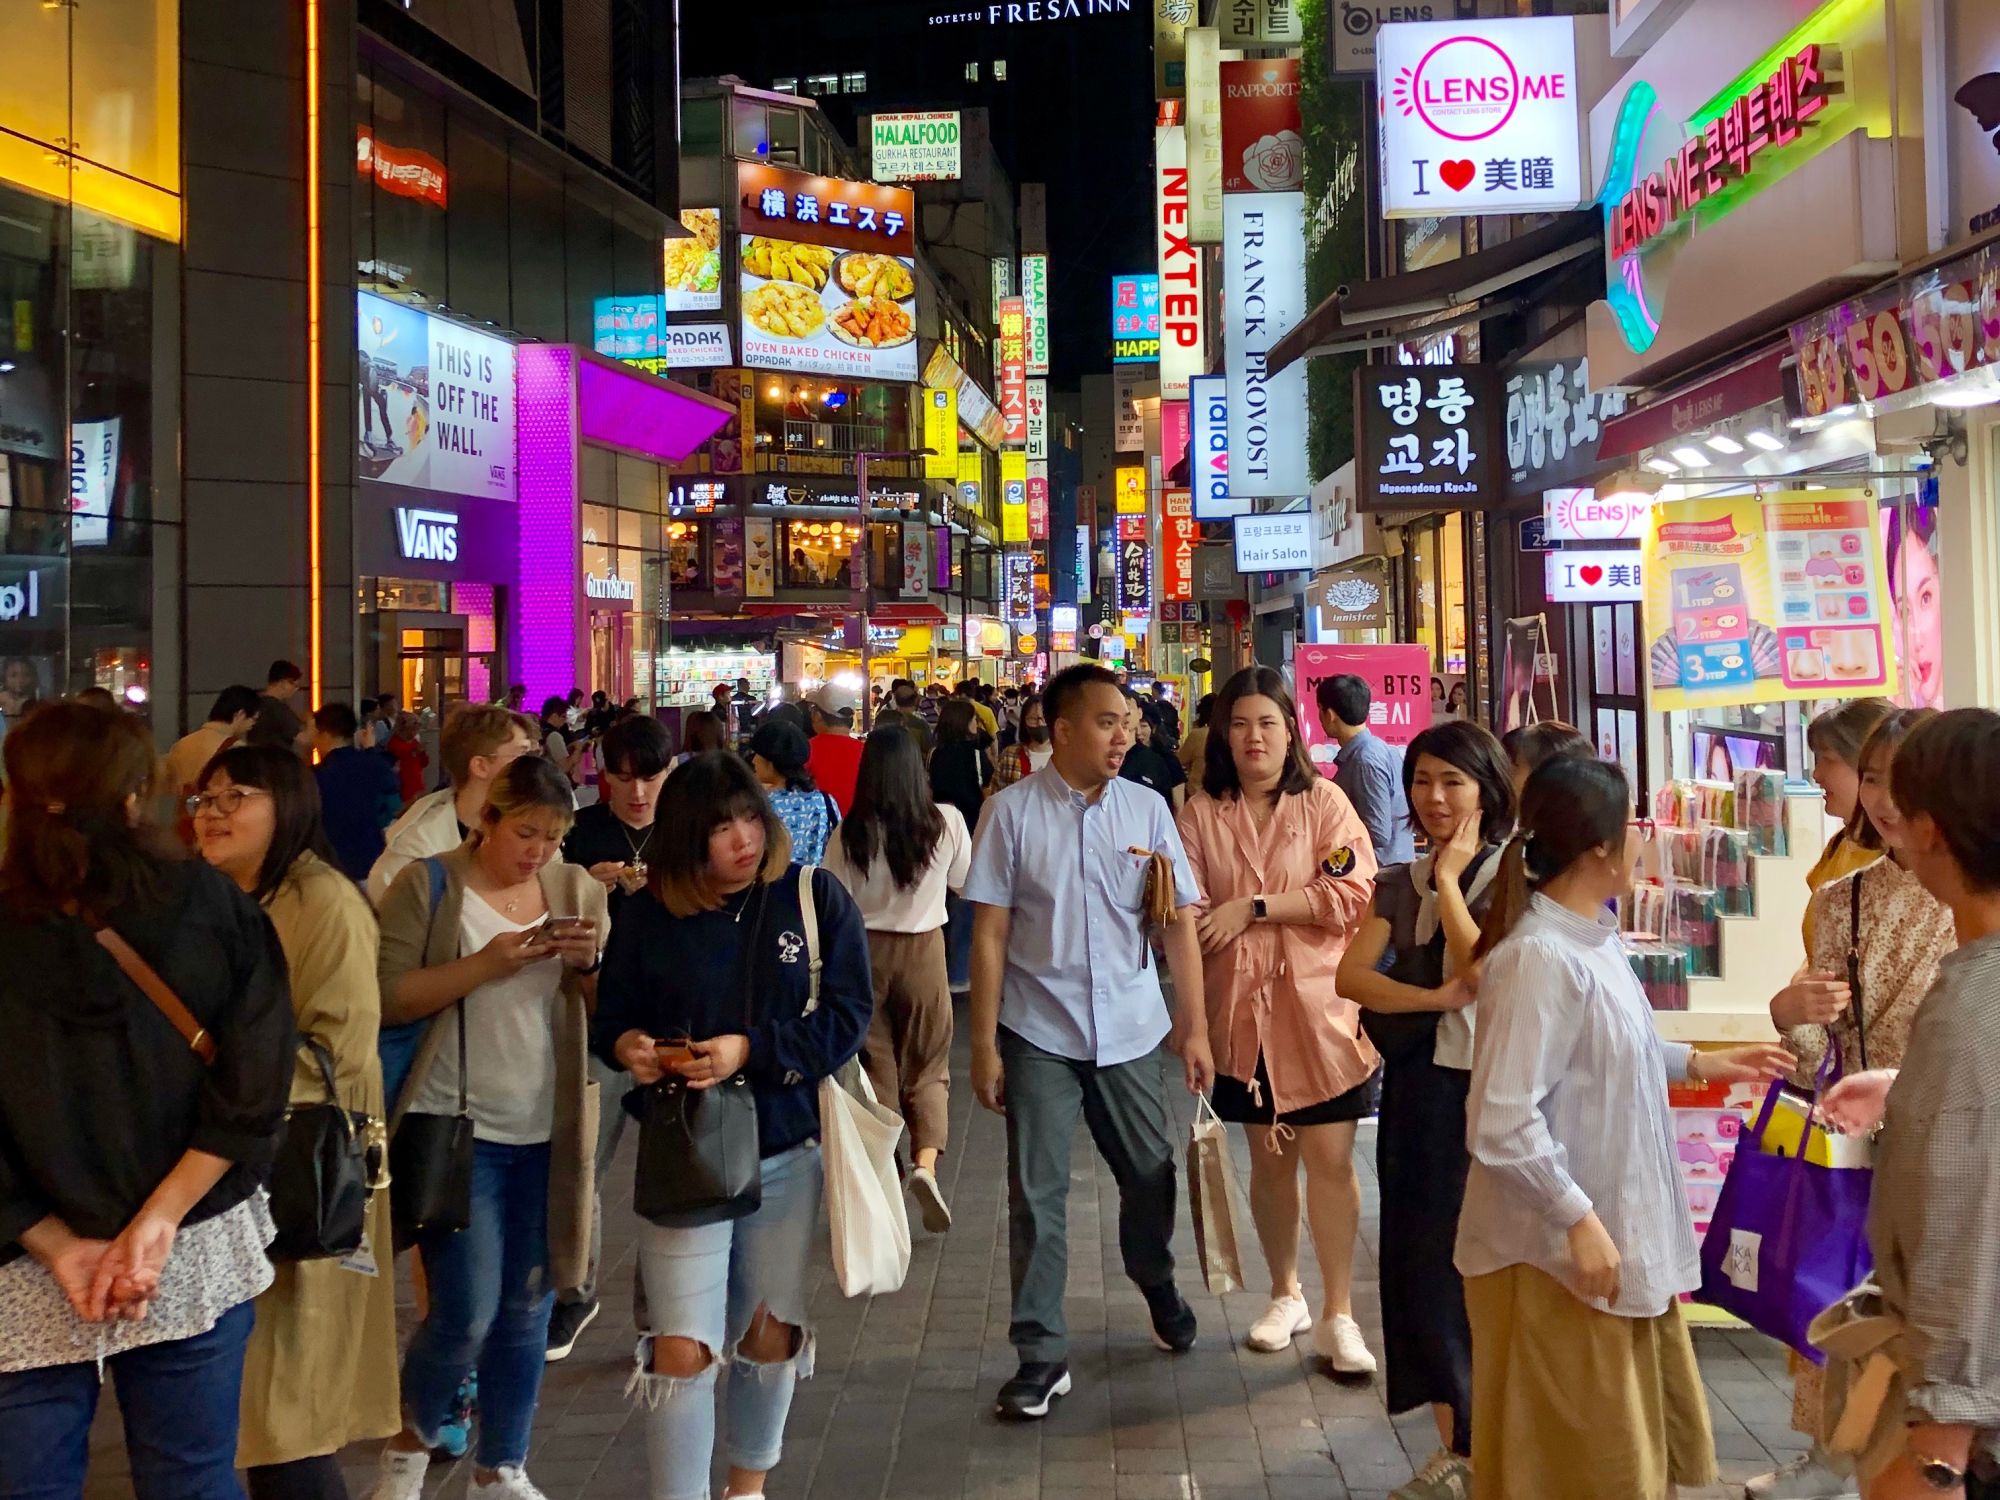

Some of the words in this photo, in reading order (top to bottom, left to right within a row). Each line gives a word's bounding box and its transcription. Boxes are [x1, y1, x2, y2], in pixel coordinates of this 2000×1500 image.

[928, 12, 981, 25] SOTETSU
[988, 1, 1081, 25] FRESA
[1227, 82, 1297, 98] RAPPORT
[1425, 76, 1509, 104] LENS
[1522, 74, 1565, 100] ME
[1432, 108, 1461, 116] CONTACT
[1482, 107, 1502, 115] STORE
[1704, 43, 1830, 196] 콘택트렌즈
[876, 149, 908, 161] GURKHA
[909, 147, 956, 159] RESTAURANT
[914, 160, 957, 172] 레스토랑
[1226, 178, 1241, 188] 4F
[1412, 159, 1430, 196] I
[1484, 156, 1555, 192] 美瞳
[761, 188, 904, 236] 横浜エステ
[1611, 172, 1666, 262] LENS
[1163, 168, 1198, 347] NEXTEP
[1033, 258, 1045, 310] HALAL
[1243, 212, 1266, 338] FRANCK
[1116, 281, 1139, 308] 足
[746, 341, 777, 354] OVEN
[781, 345, 819, 358] BAKED
[823, 349, 872, 363] CHICKEN
[1034, 317, 1046, 362] FOOD
[1115, 340, 1160, 357] HAPP
[436, 340, 472, 377] THIS
[479, 355, 493, 384] IS
[745, 354, 792, 367] OPPADAK
[437, 381, 465, 415] OFF
[472, 390, 499, 423] THE
[1378, 377, 1475, 426] 명동
[1245, 350, 1269, 481] PROVOST
[437, 420, 483, 457] WALL.
[1379, 428, 1477, 476] 교자
[489, 465, 506, 481] VANS
[690, 491, 724, 500] DESSERT
[1379, 482, 1442, 495] Myeongdong
[1574, 505, 1624, 522] LENS
[397, 506, 458, 562] VANS
[1243, 525, 1303, 537] 프랑크프로보
[1243, 549, 1269, 561] Hair
[1272, 548, 1308, 561] Salon
[1564, 563, 1576, 588] I
[1690, 597, 1715, 607] STEP
[1681, 618, 1700, 641] 2
[1699, 629, 1723, 640] STEP
[1686, 654, 1706, 683] 3
[1384, 675, 1421, 696] BTS
[1368, 700, 1411, 725] 출시
